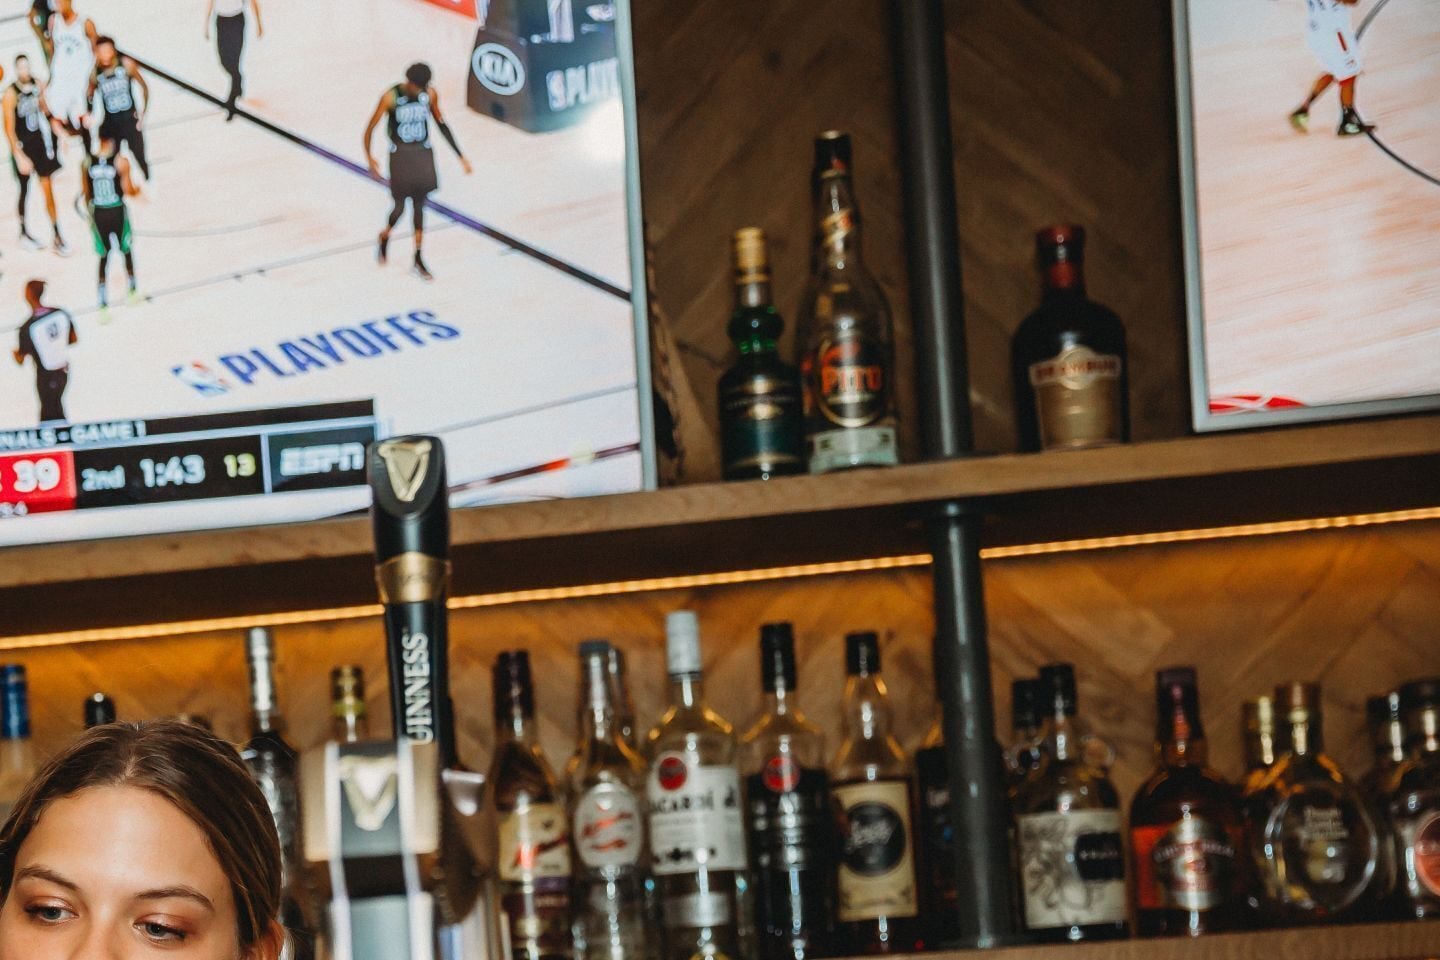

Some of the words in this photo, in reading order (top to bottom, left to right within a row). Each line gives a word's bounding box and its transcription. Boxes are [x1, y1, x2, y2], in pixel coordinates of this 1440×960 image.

[220, 308, 460, 386] PLAYOFFS
[70, 420, 133, 444] GAME
[12, 458, 61, 492] 39
[81, 464, 126, 491] 2nd
[139, 453, 206, 488] 1:43
[223, 452, 257, 478] 13
[280, 441, 366, 477] ESPN
[401, 631, 434, 745] UINNESS
